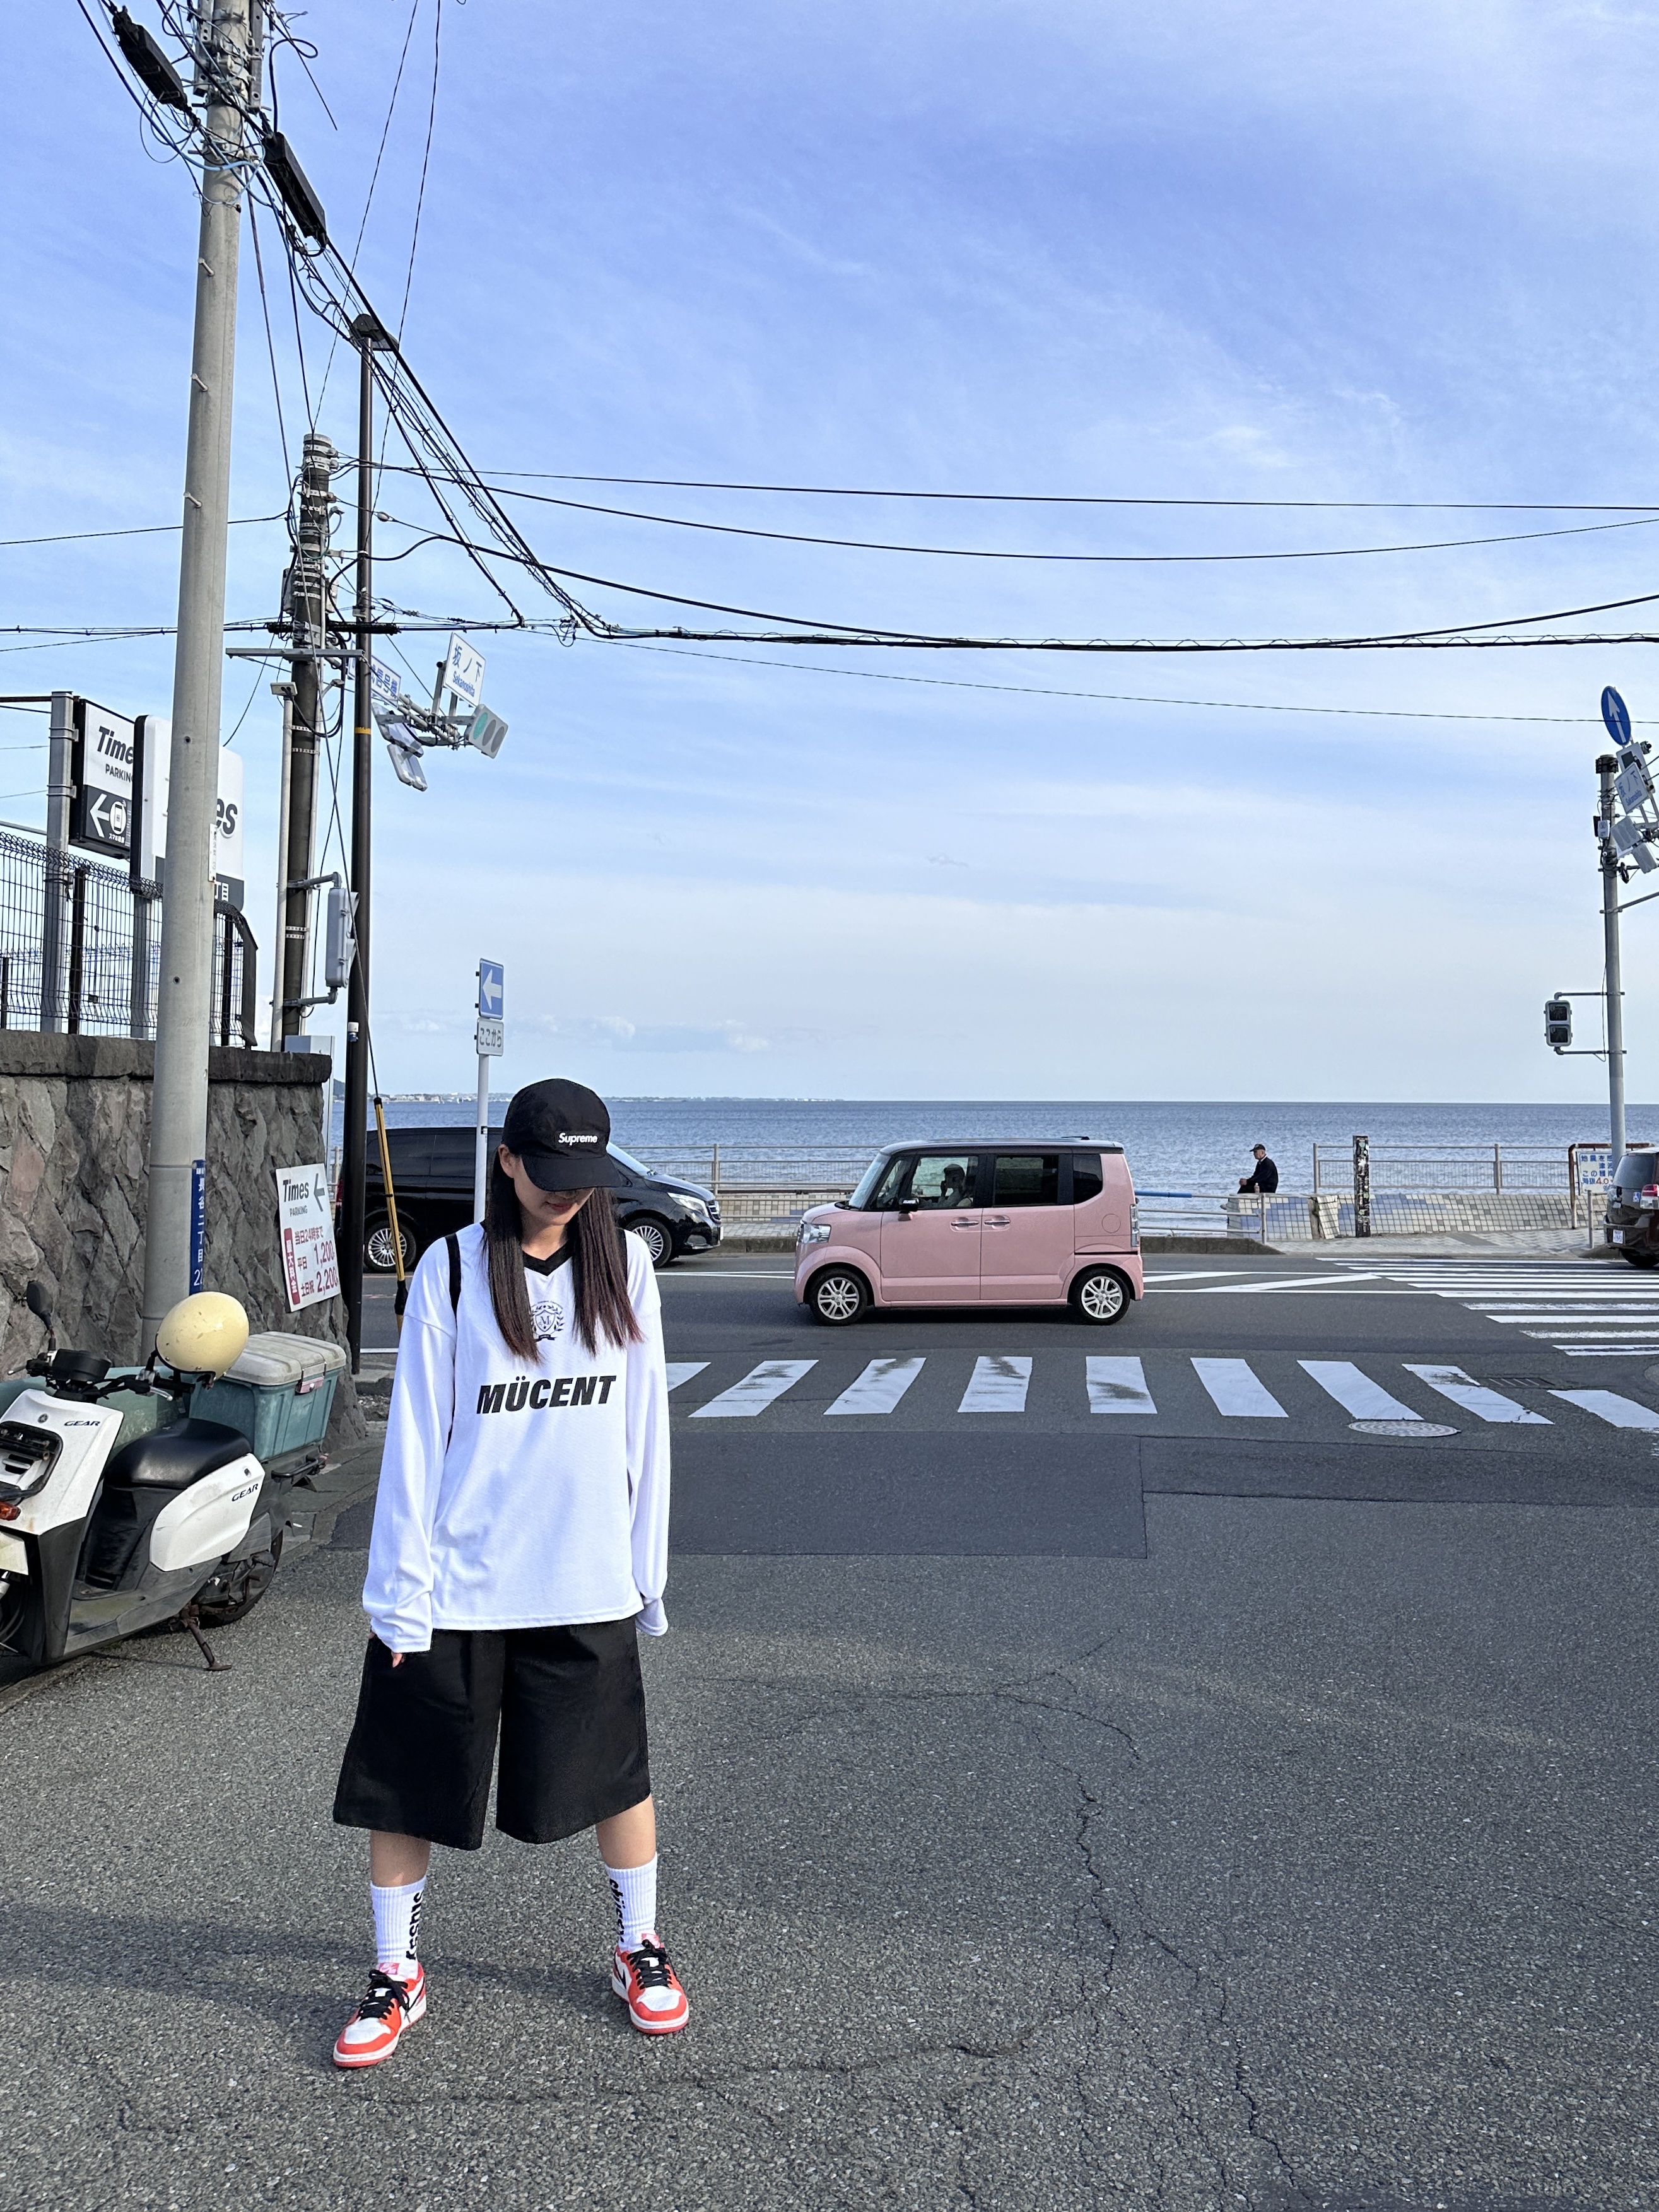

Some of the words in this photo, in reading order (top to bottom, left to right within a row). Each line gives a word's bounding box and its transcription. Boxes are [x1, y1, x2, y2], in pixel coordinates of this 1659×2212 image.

[452, 643, 482, 683] 坂ノ下
[97, 725, 133, 764] Time
[105, 763, 133, 783] PARKIN
[479, 1027, 502, 1048] ここから
[558, 1132, 598, 1146] Supreme
[283, 1179, 309, 1202] Times
[290, 1205, 308, 1217] PARKING
[297, 1256, 307, 1271] 平日
[476, 1375, 617, 1415] MÜCENT
[232, 1483, 259, 1502] GEAR
